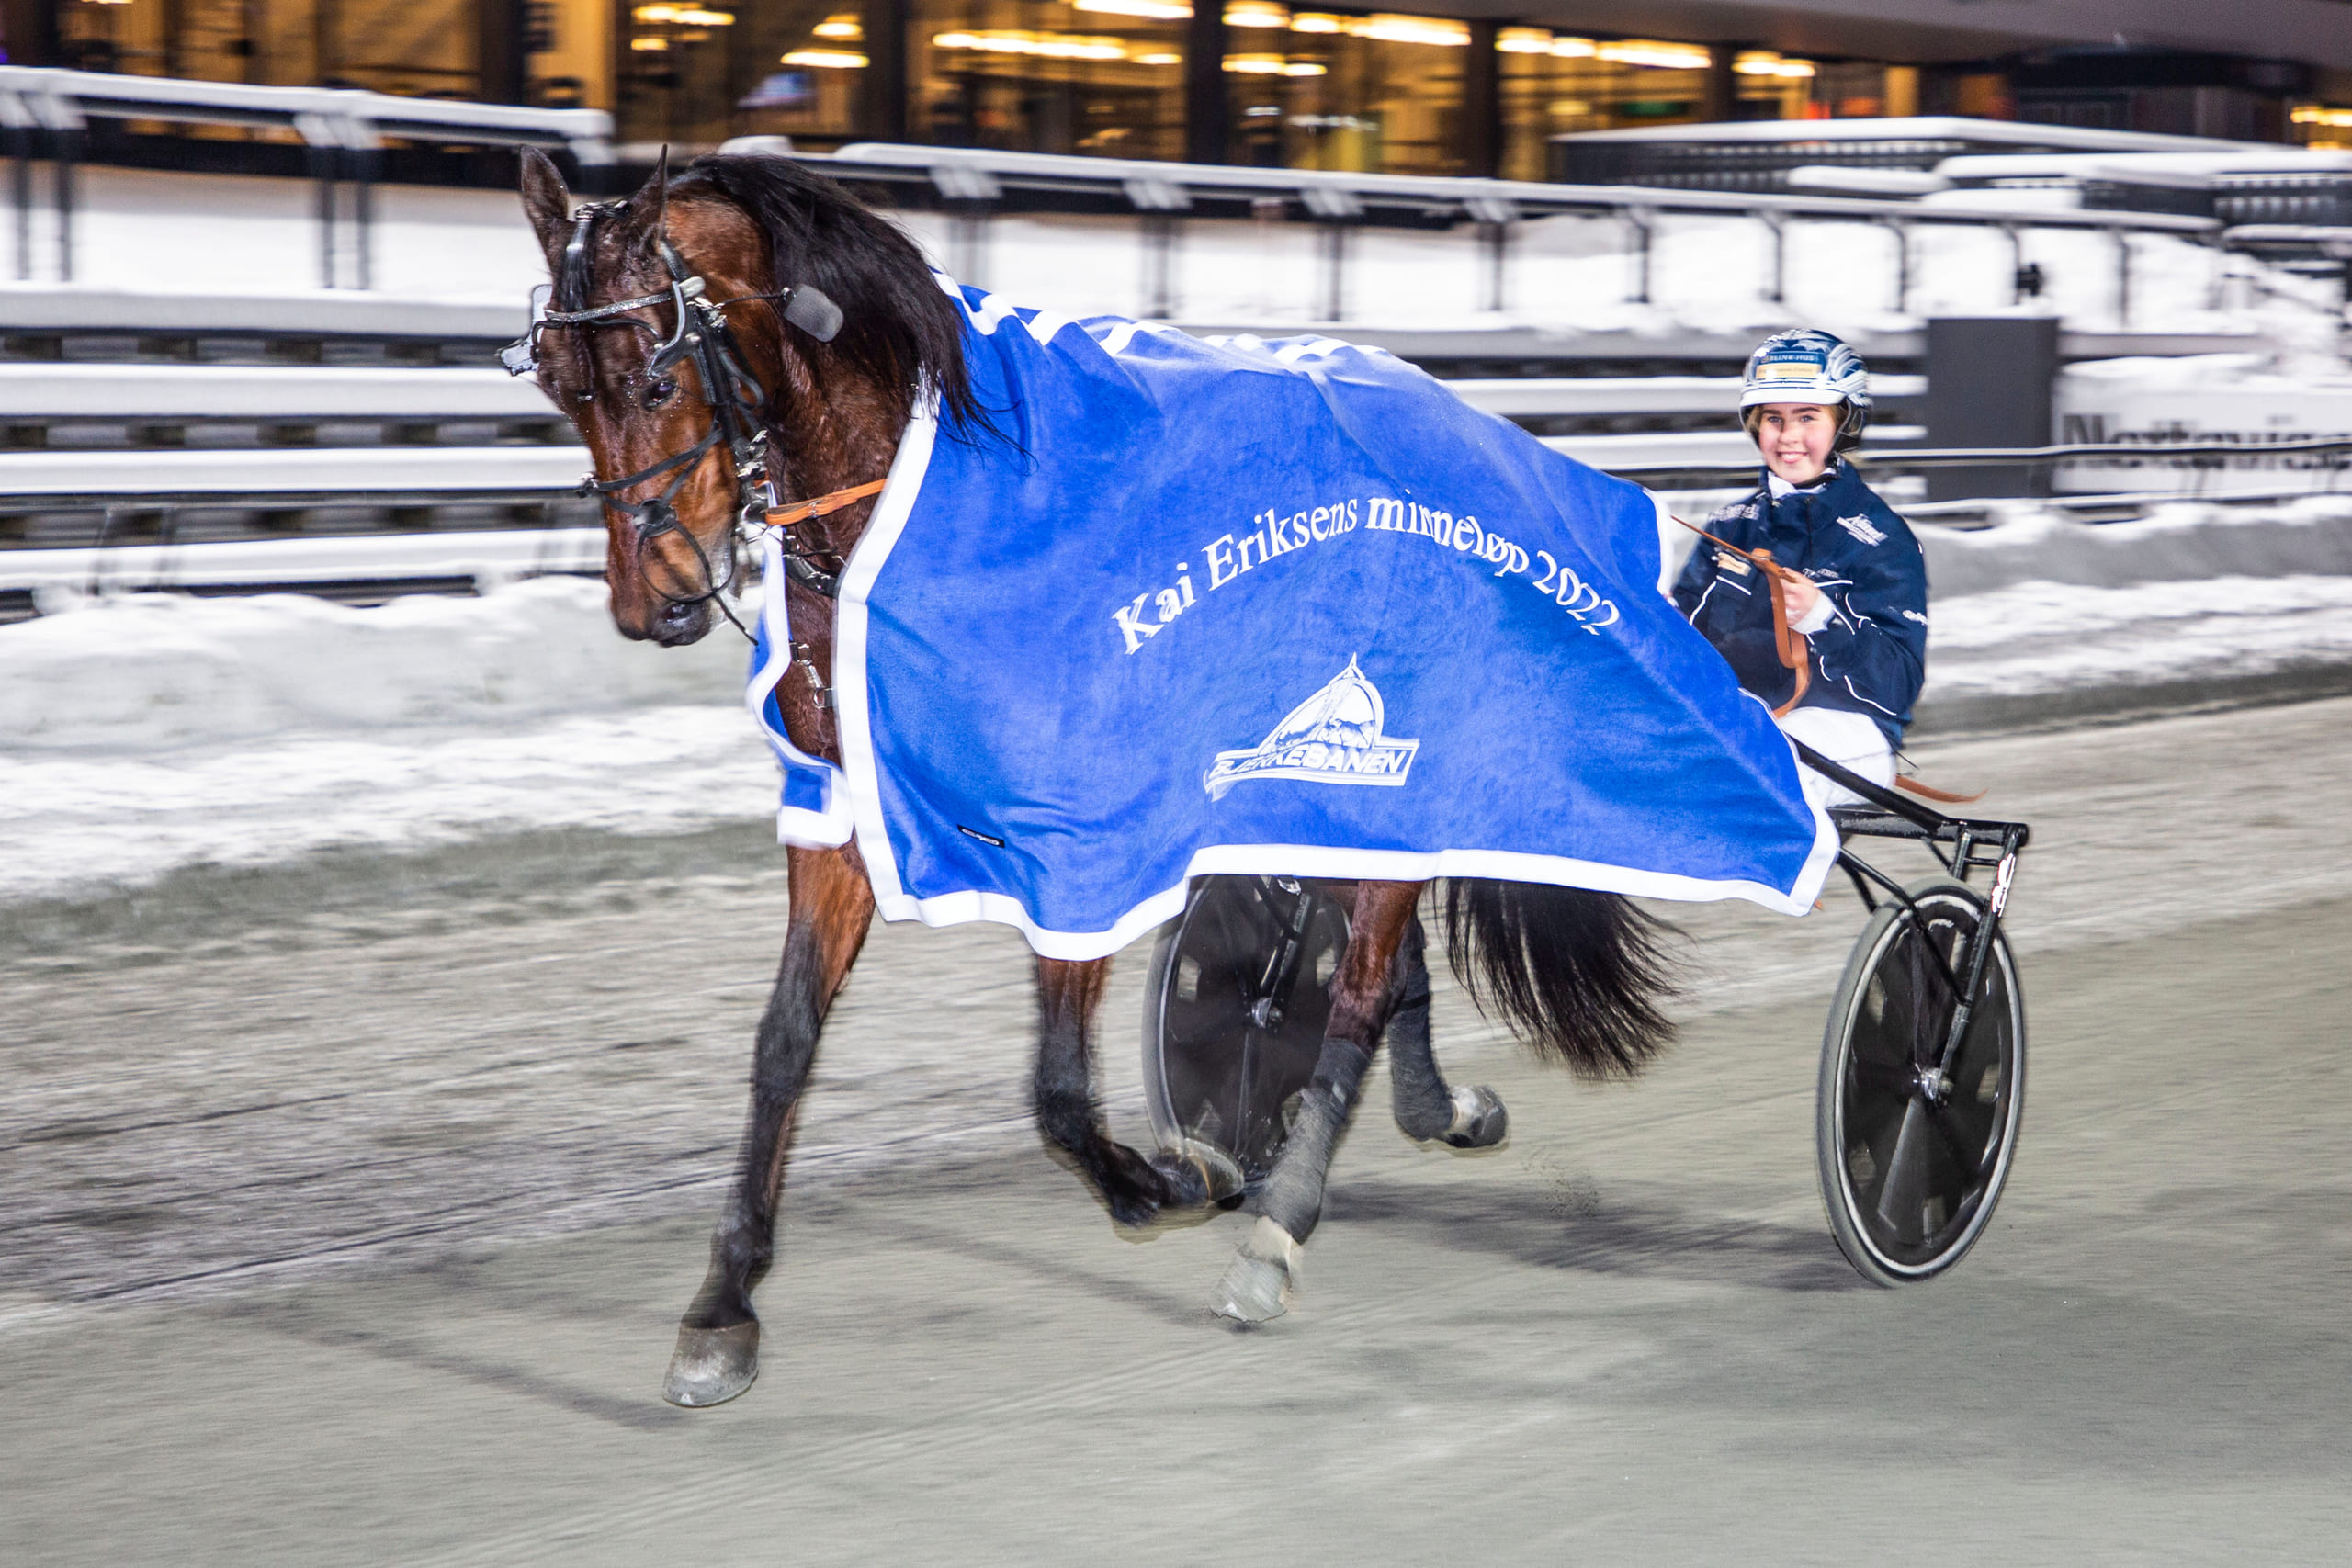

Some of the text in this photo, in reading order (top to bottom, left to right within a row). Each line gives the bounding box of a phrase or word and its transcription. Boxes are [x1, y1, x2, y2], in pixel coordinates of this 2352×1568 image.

[1112, 562, 1196, 655] Kai
[1201, 497, 1358, 592] Eriksens
[1532, 550, 1621, 636] 2022
